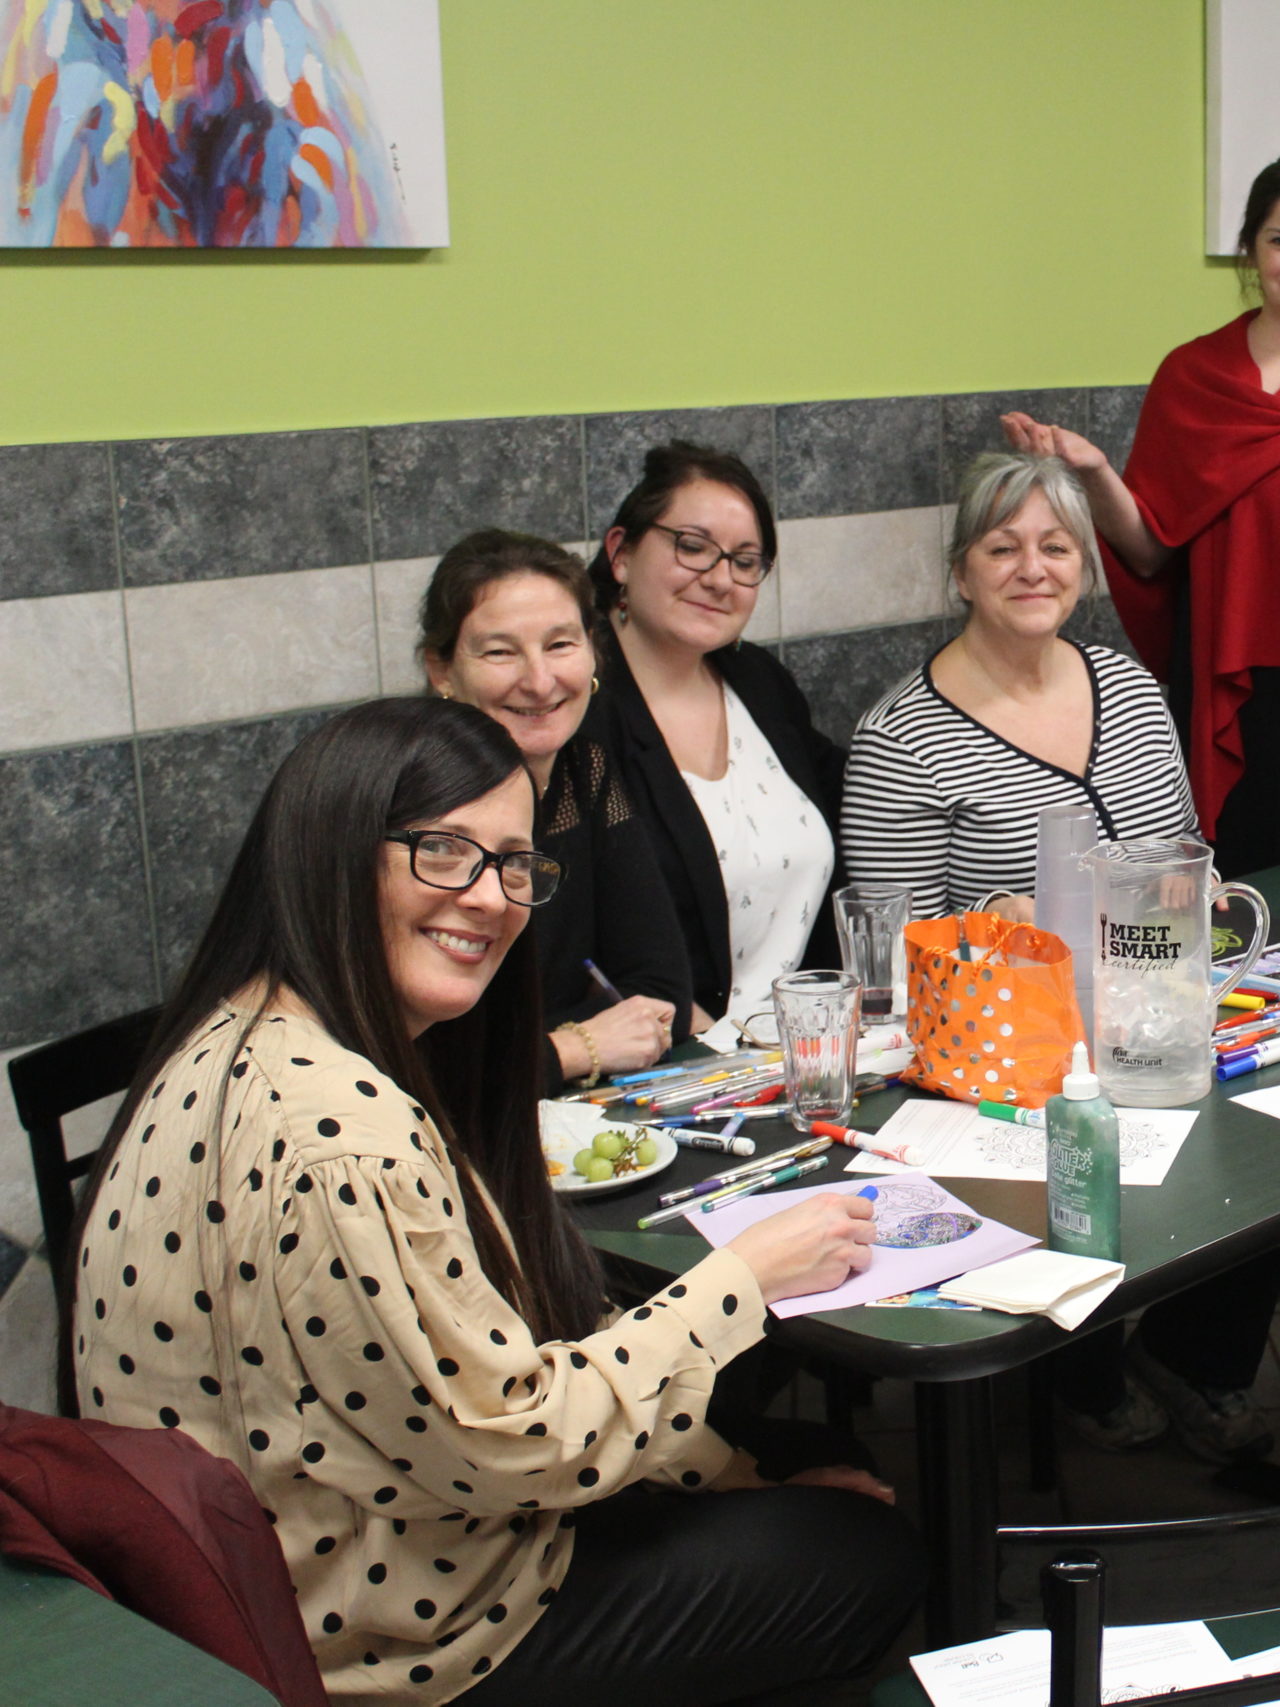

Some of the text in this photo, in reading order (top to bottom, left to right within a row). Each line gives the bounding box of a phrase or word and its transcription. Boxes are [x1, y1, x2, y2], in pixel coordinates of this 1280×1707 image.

[1110, 923, 1171, 942] MEET
[1109, 941, 1182, 959] SMART
[1108, 958, 1177, 978] certified
[1116, 1057, 1143, 1066] HEALTH
